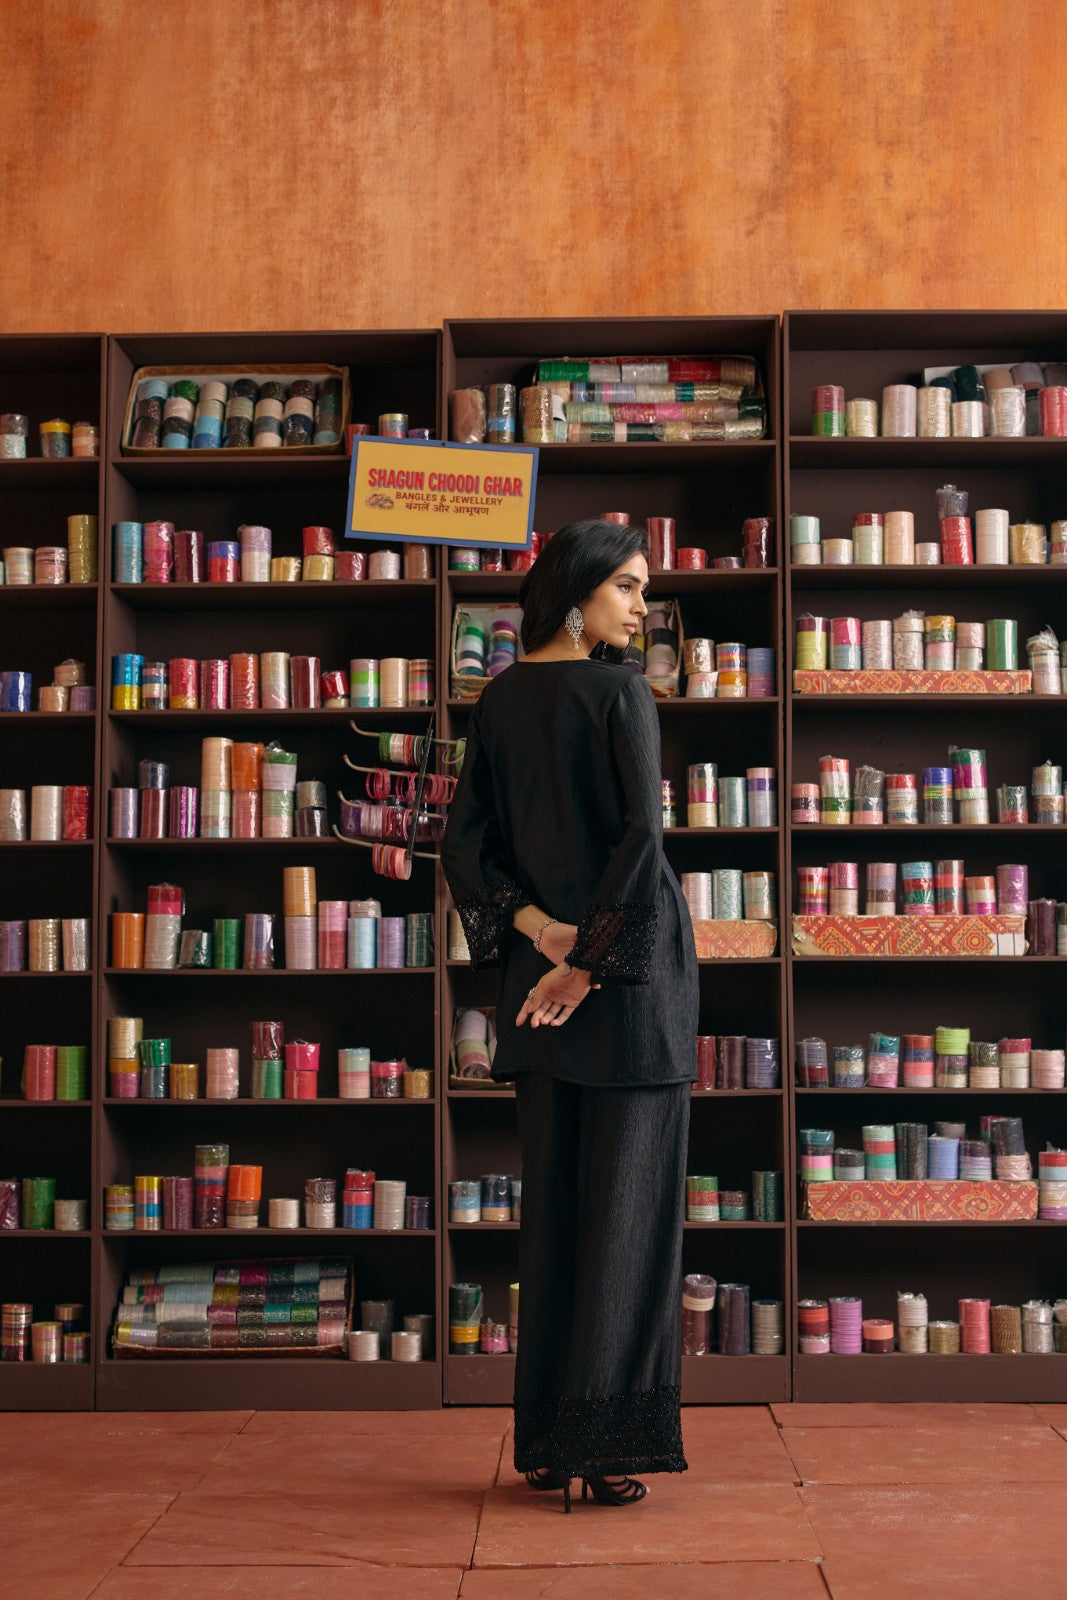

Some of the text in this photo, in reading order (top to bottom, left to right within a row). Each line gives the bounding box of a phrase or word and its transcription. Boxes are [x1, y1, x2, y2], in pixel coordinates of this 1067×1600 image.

[368, 468, 523, 497] SHAGUN CHOODI GHAR
[395, 492, 503, 506] BANGLES & JEWELLERY
[433, 502, 450, 514] और
[453, 505, 489, 517] आभूषण
